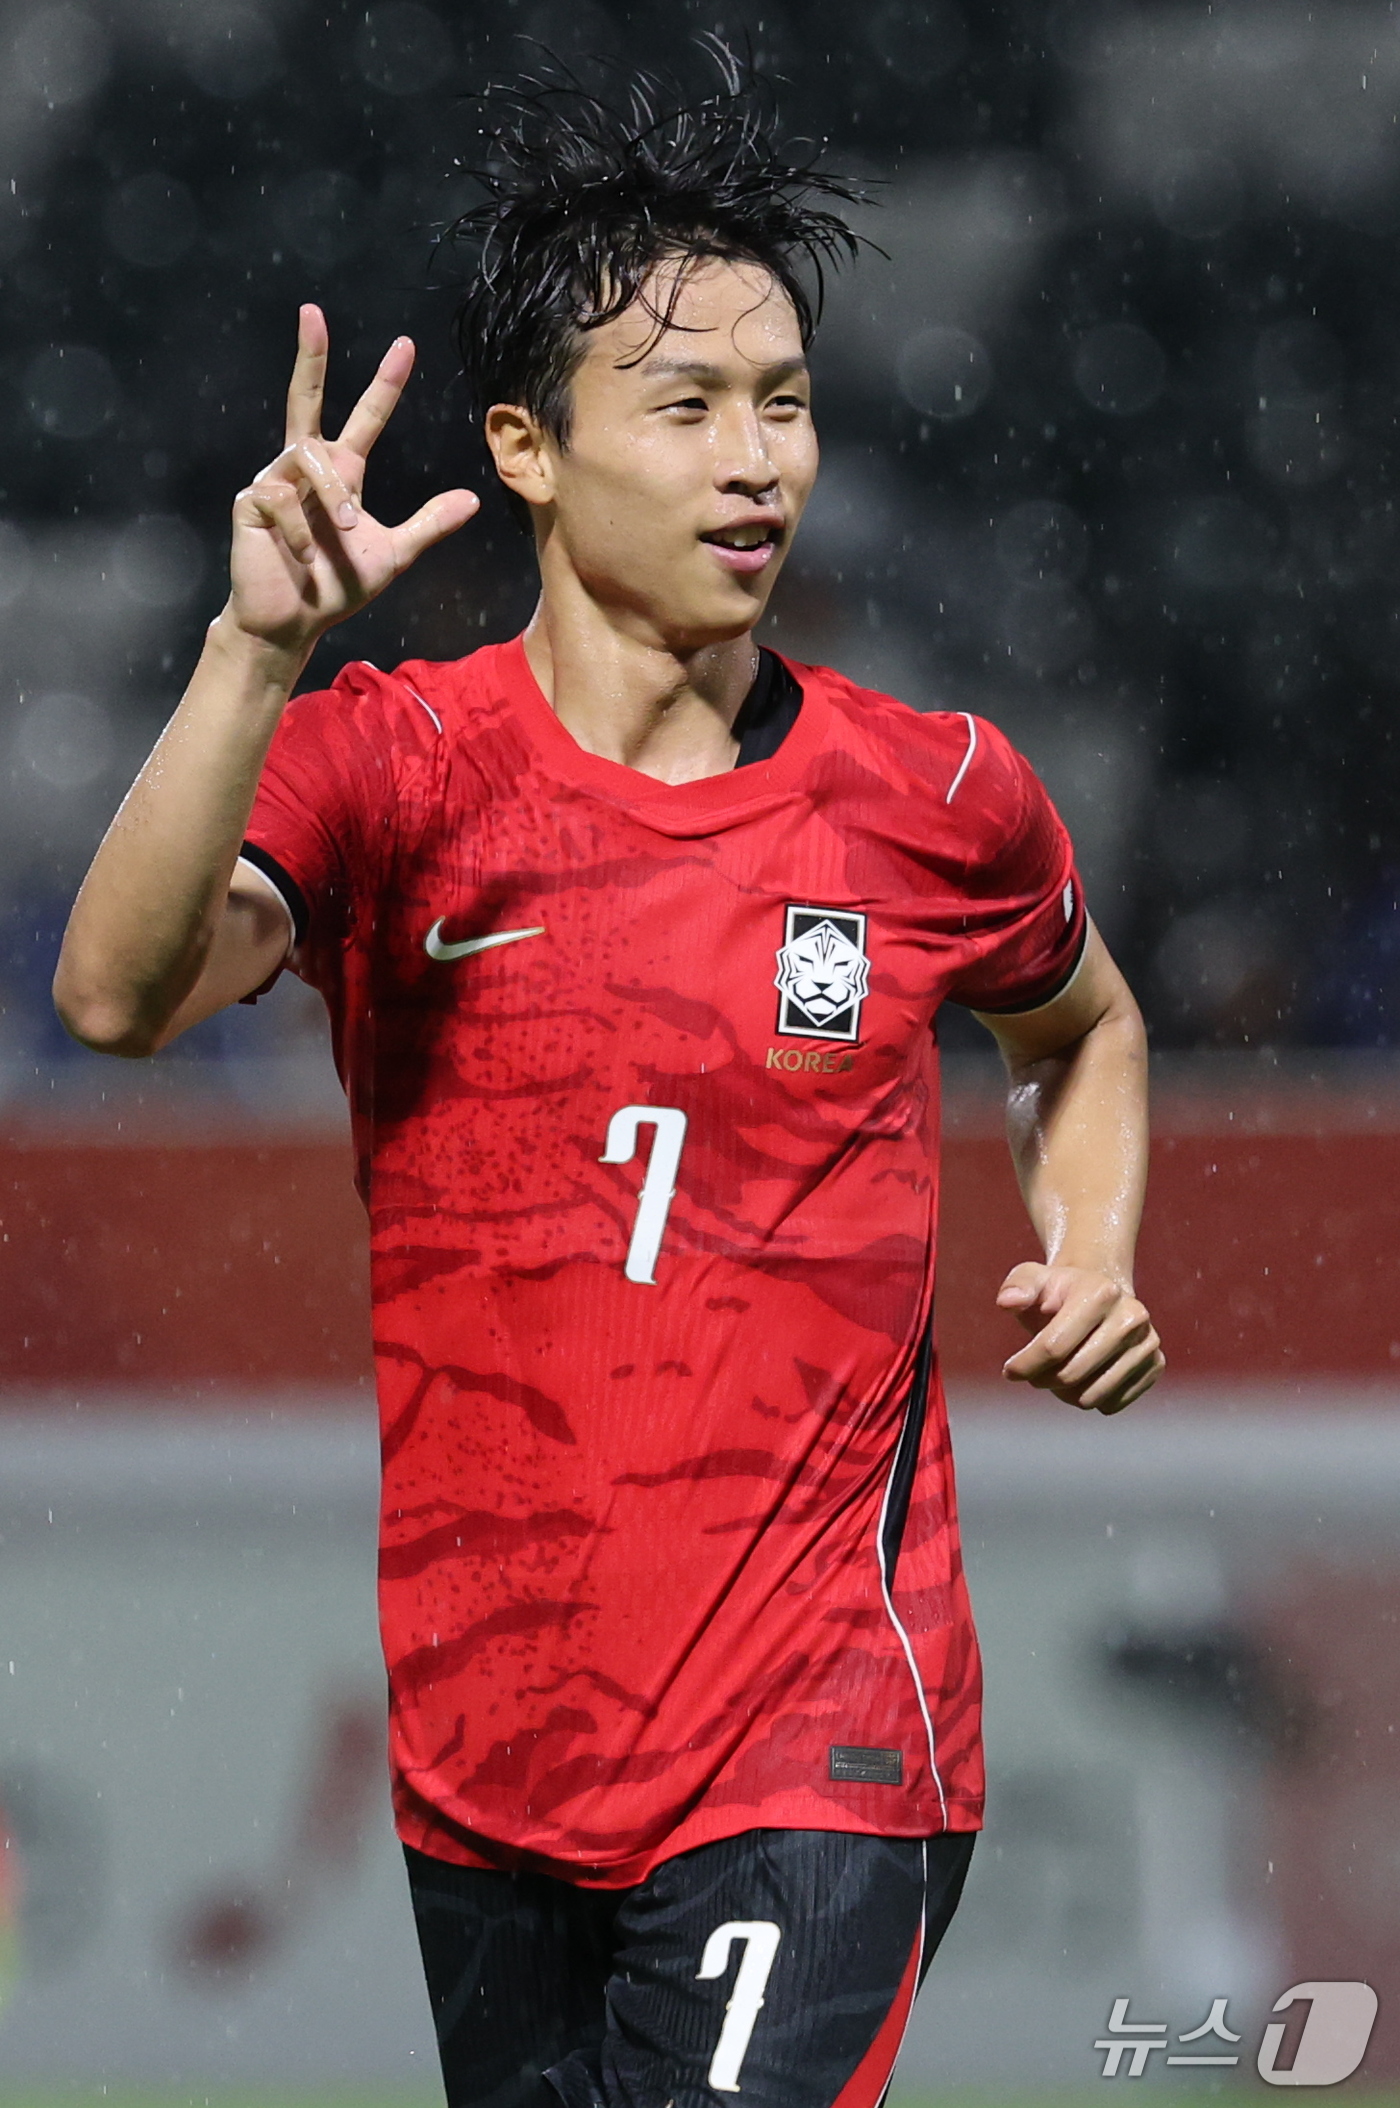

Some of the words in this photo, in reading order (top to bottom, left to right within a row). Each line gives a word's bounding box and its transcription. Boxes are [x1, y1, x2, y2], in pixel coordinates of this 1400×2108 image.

[766, 1048, 854, 1073] KOREA
[598, 1105, 688, 1285] 7
[695, 1921, 781, 2092] 7
